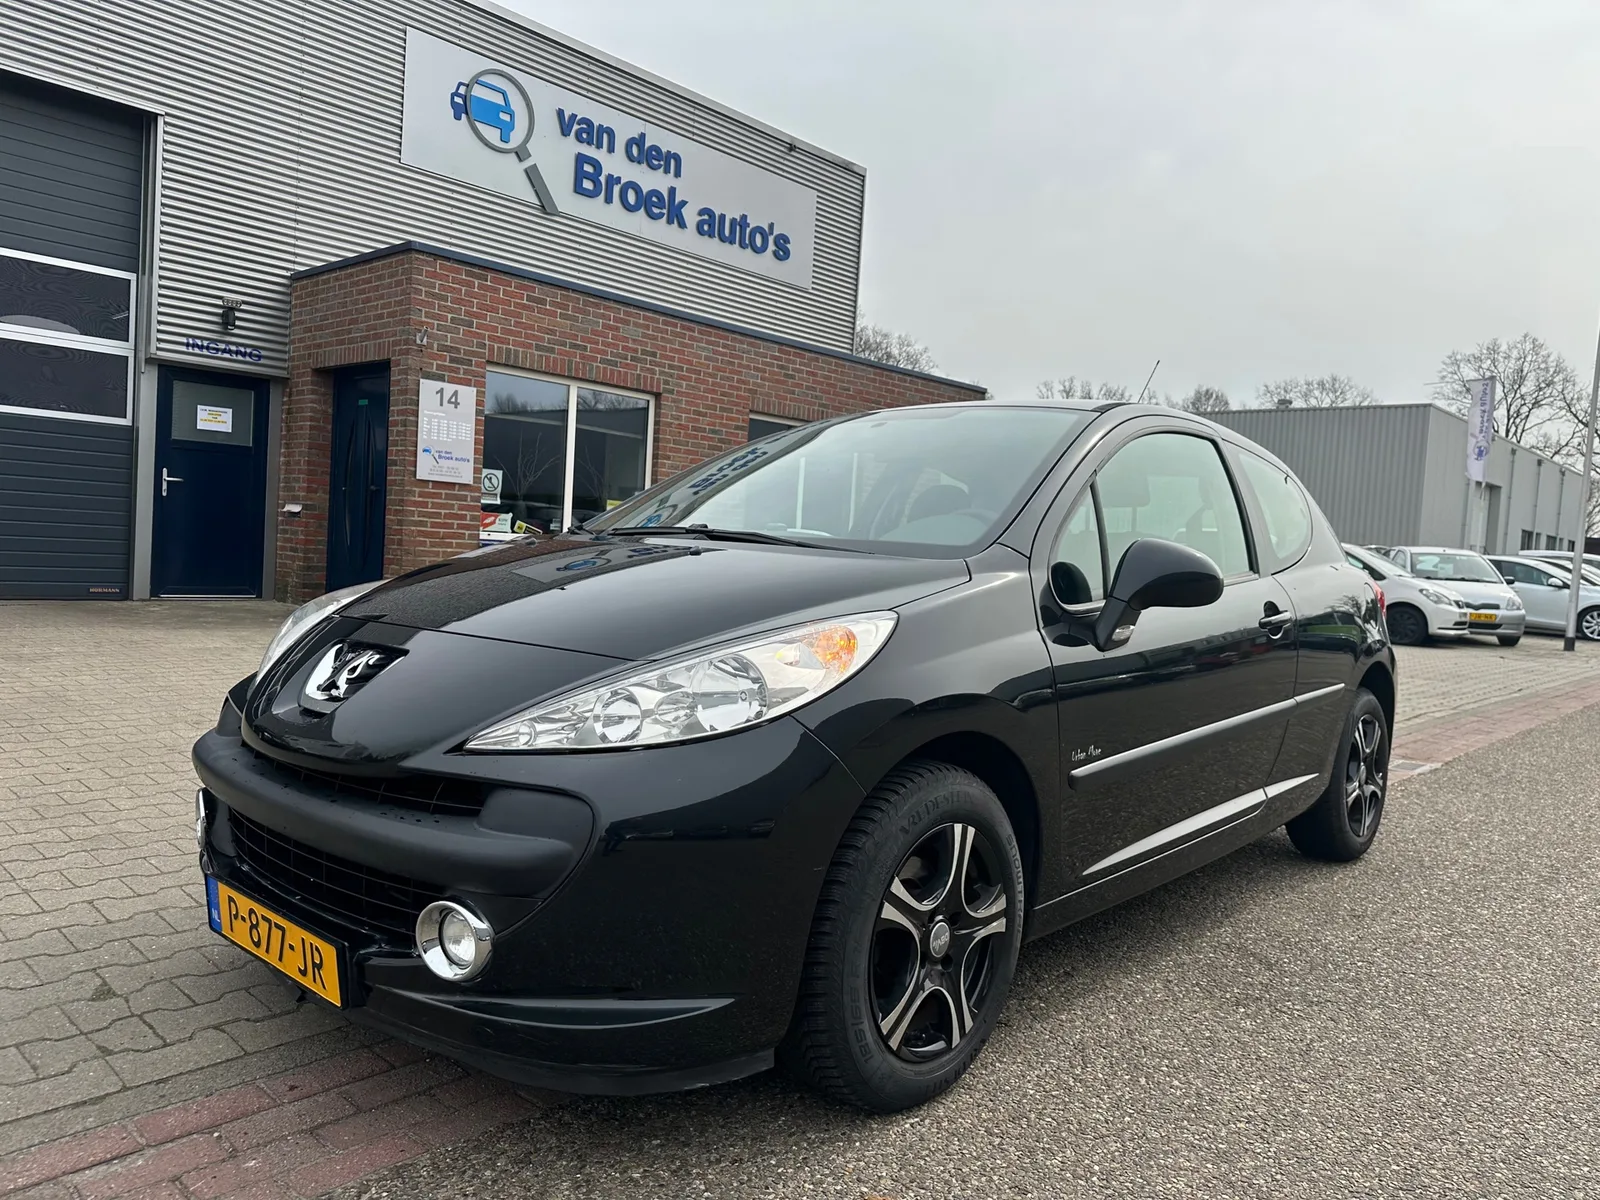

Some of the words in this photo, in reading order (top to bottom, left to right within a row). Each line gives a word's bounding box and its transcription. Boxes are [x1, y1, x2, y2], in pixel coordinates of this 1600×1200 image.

[556, 106, 616, 155] van
[625, 131, 682, 179] den
[573, 151, 689, 229] Broek
[695, 206, 792, 262] auto's
[184, 336, 263, 362] INGANG
[435, 387, 461, 409] 14
[211, 907, 221, 923] NL
[226, 893, 328, 992] P-877-JR
